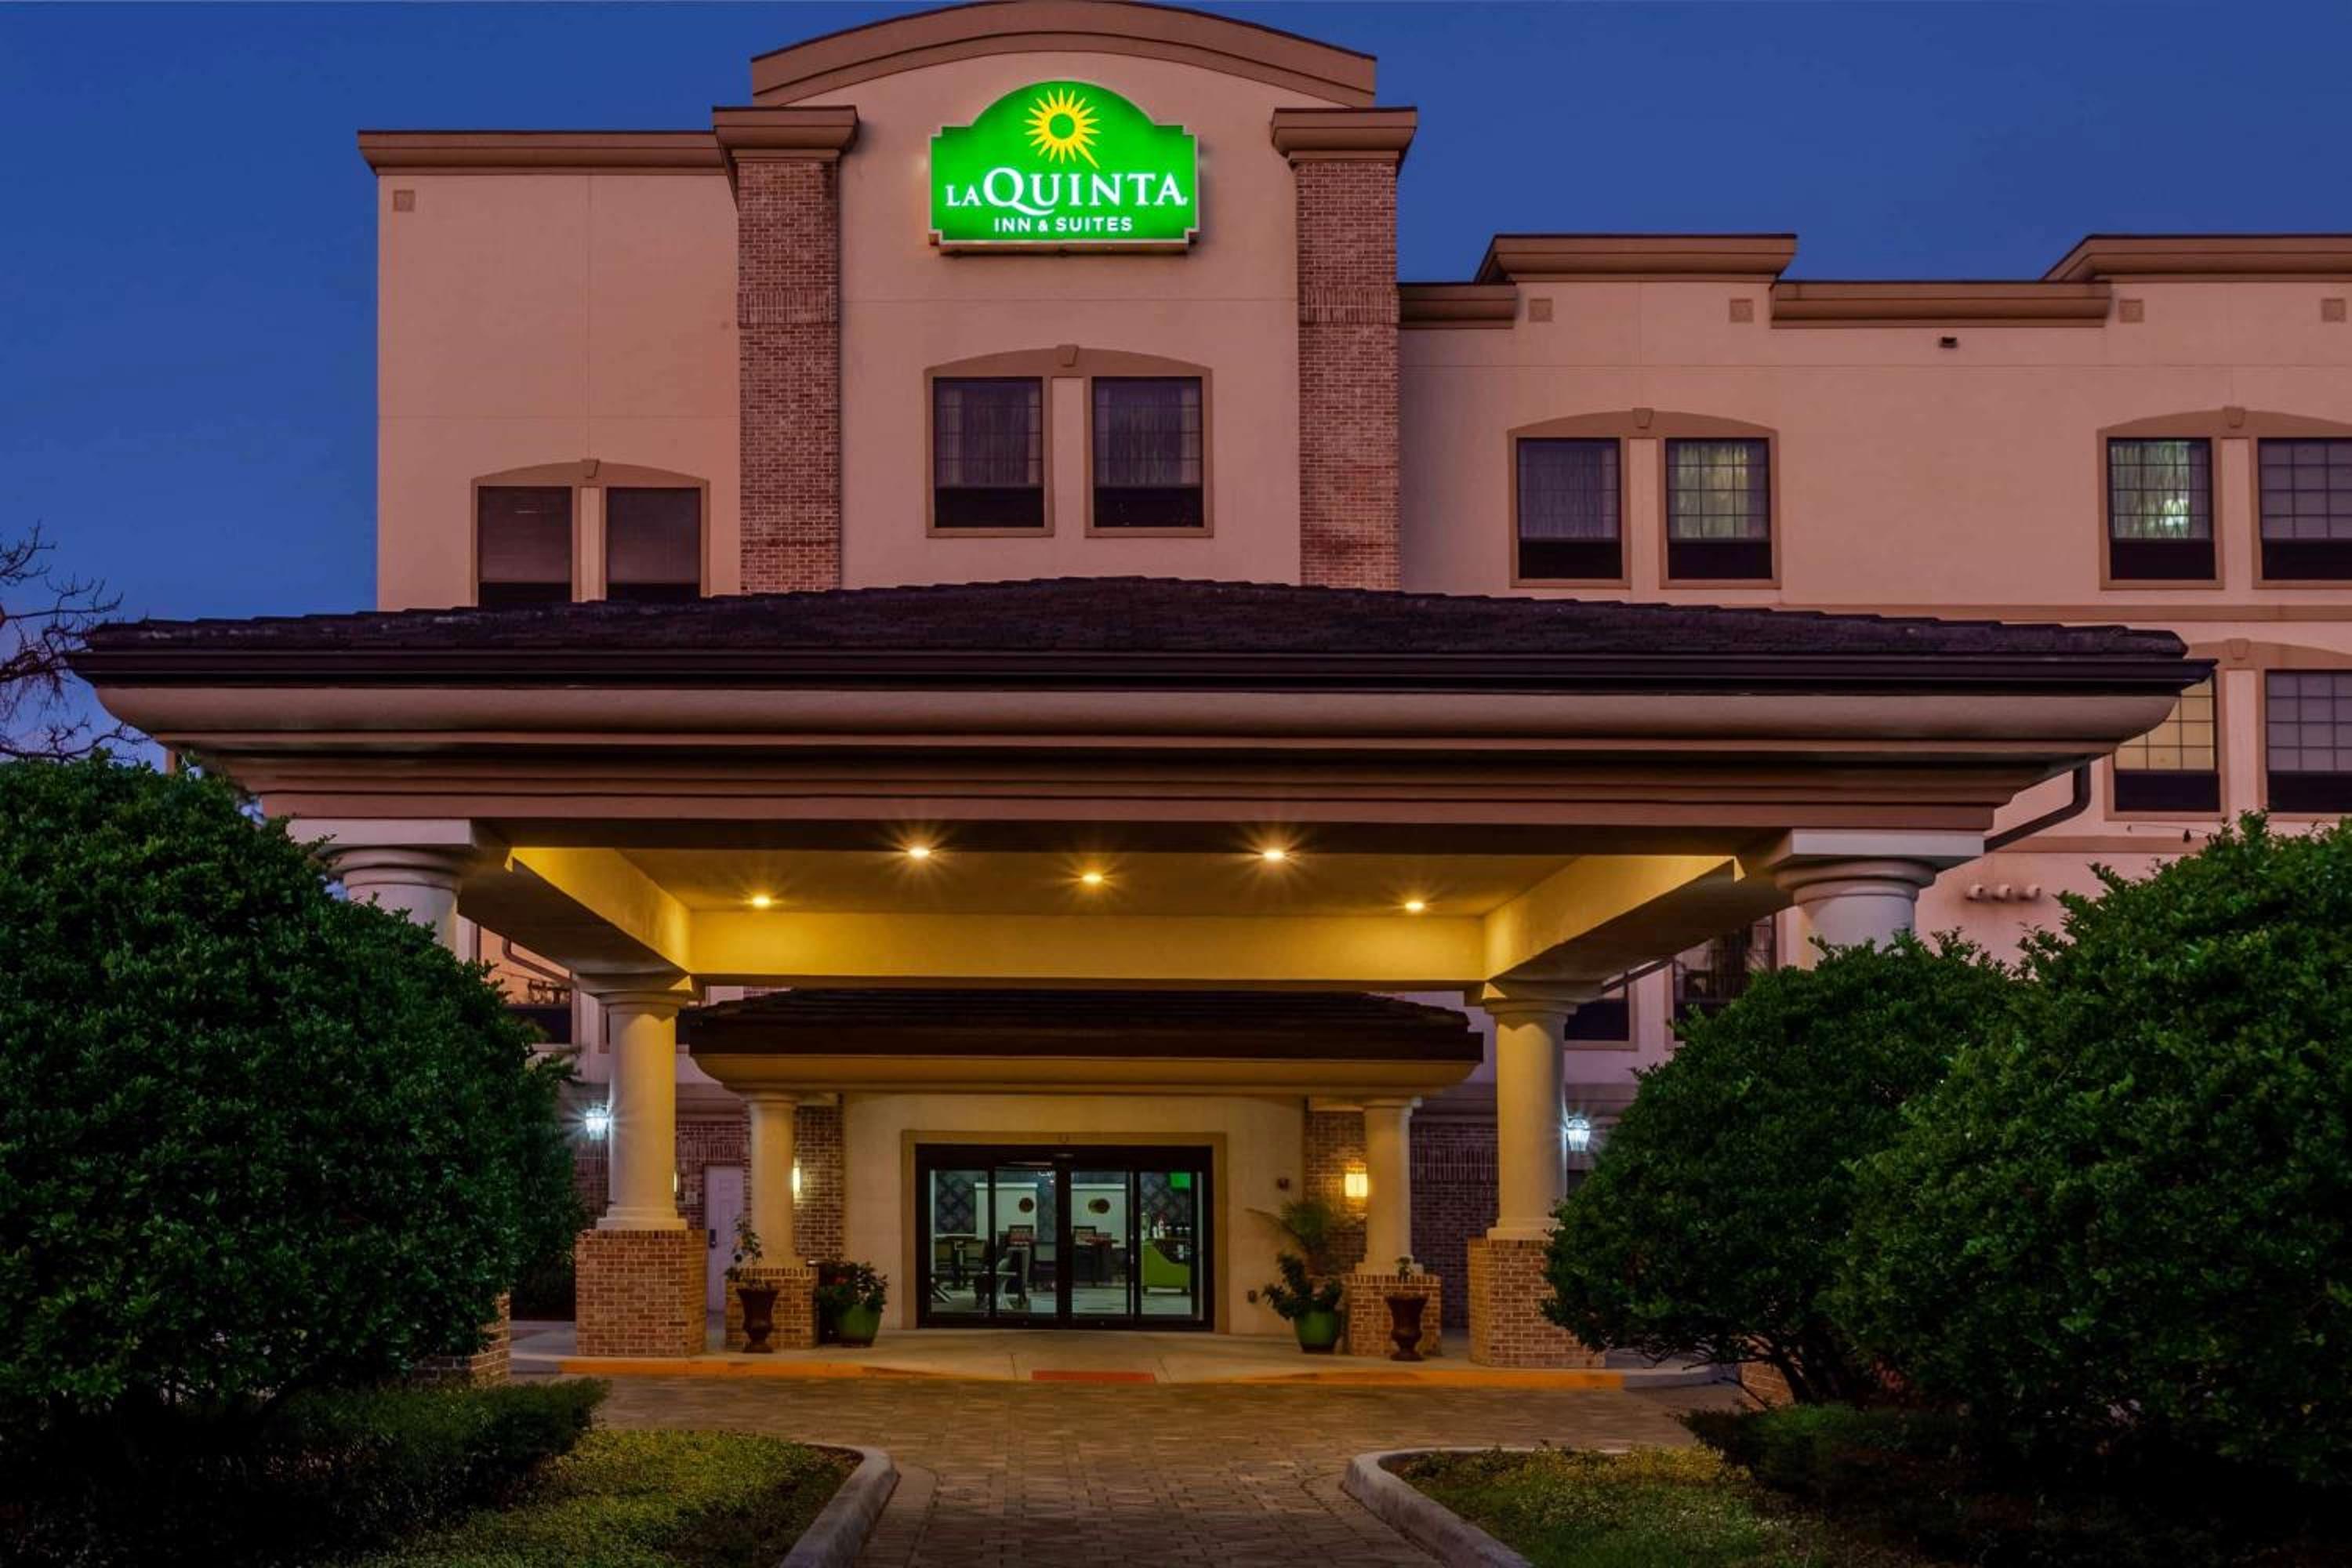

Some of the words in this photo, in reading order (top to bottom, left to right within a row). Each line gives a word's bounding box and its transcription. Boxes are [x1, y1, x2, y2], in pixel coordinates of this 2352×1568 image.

[945, 184, 982, 206] LA
[982, 166, 1189, 216] QUINTA
[994, 218, 1032, 232] INN
[1037, 219, 1049, 232] &
[1055, 217, 1133, 231] SUITES
